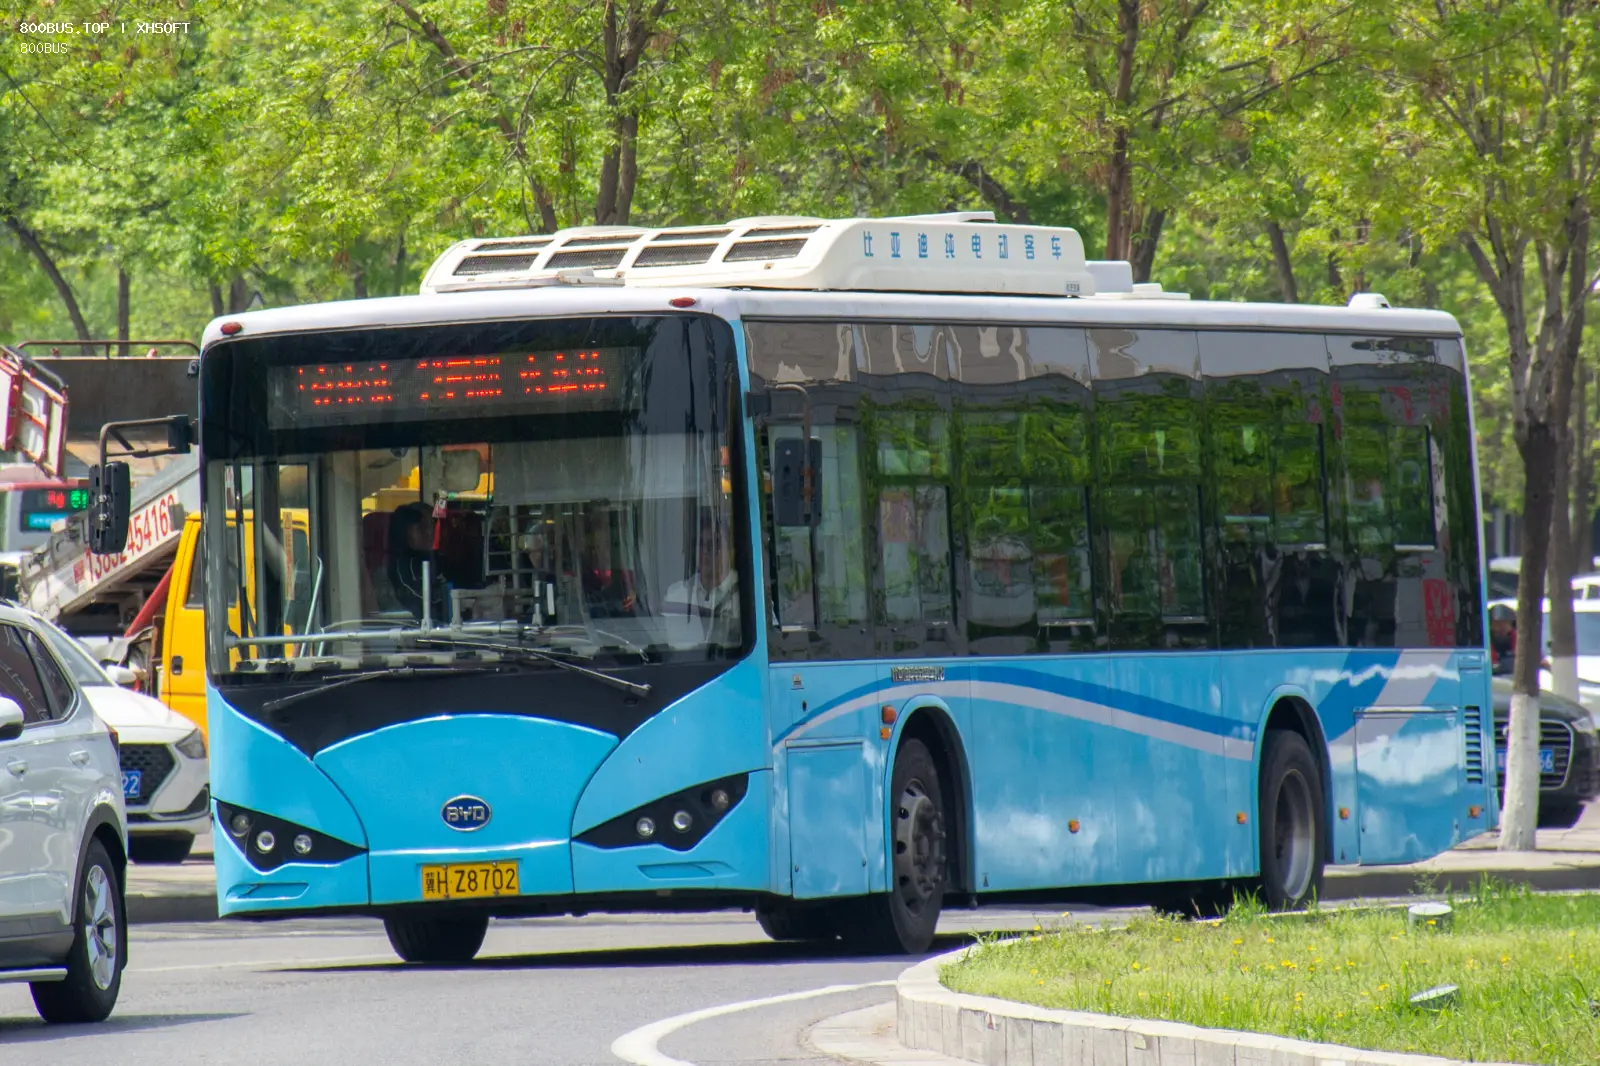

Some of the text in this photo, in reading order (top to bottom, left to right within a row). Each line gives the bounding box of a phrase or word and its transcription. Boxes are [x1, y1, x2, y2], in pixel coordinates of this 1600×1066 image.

[863, 230, 1062, 260] 比亚迪纯电动客车
[446, 805, 486, 822] BYD
